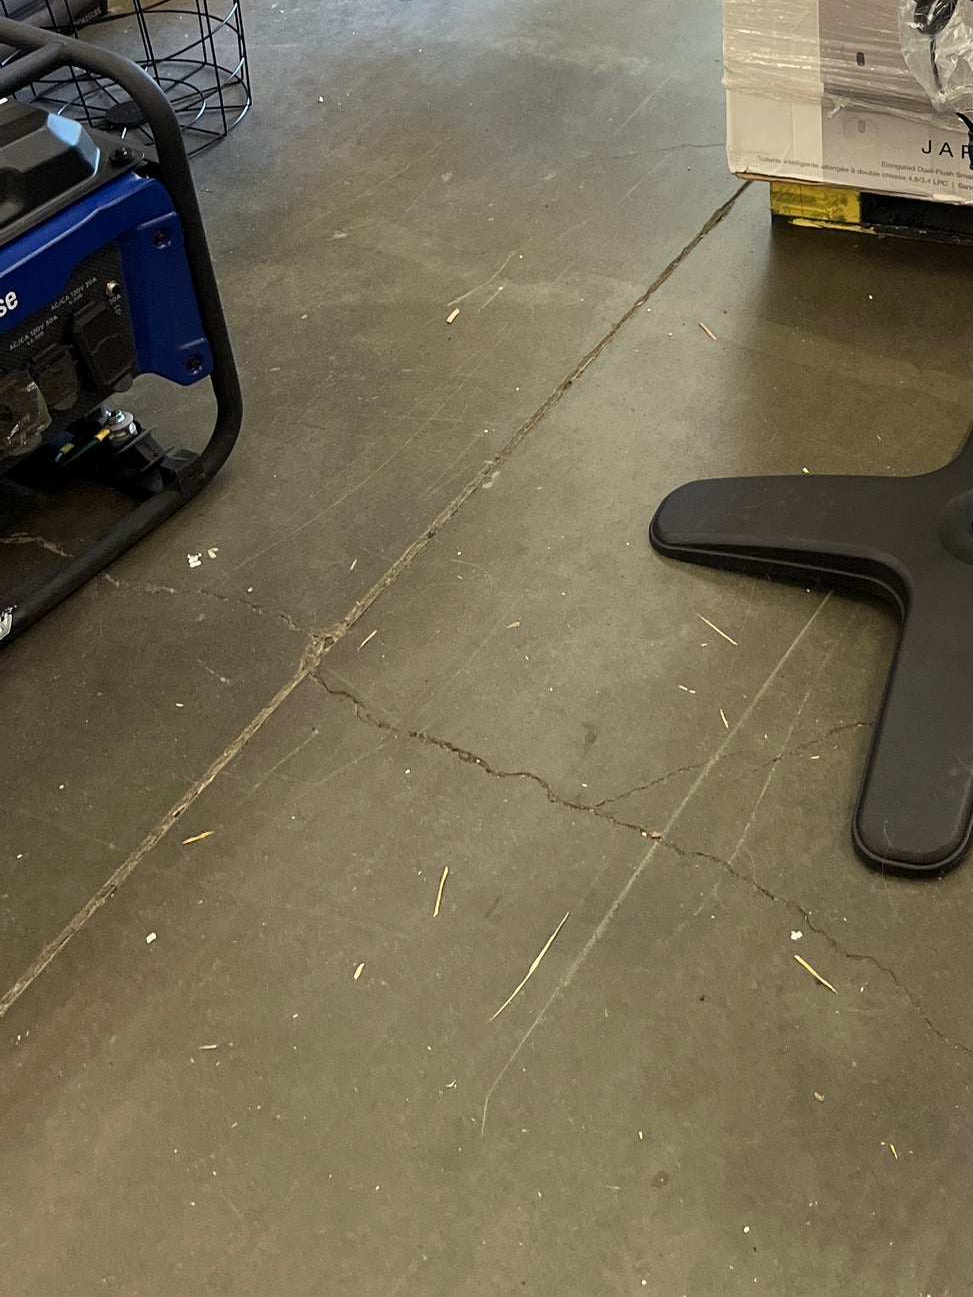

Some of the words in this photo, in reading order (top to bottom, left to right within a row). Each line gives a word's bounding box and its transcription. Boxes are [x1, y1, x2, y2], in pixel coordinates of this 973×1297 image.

[757, 155, 782, 164] Toilette
[783, 158, 819, 170] intelligente
[820, 162, 849, 174] allongée
[856, 168, 880, 178] double
[932, 179, 948, 187] LPC
[881, 160, 916, 172] Elongated
[917, 165, 955, 177] Dual-Flush
